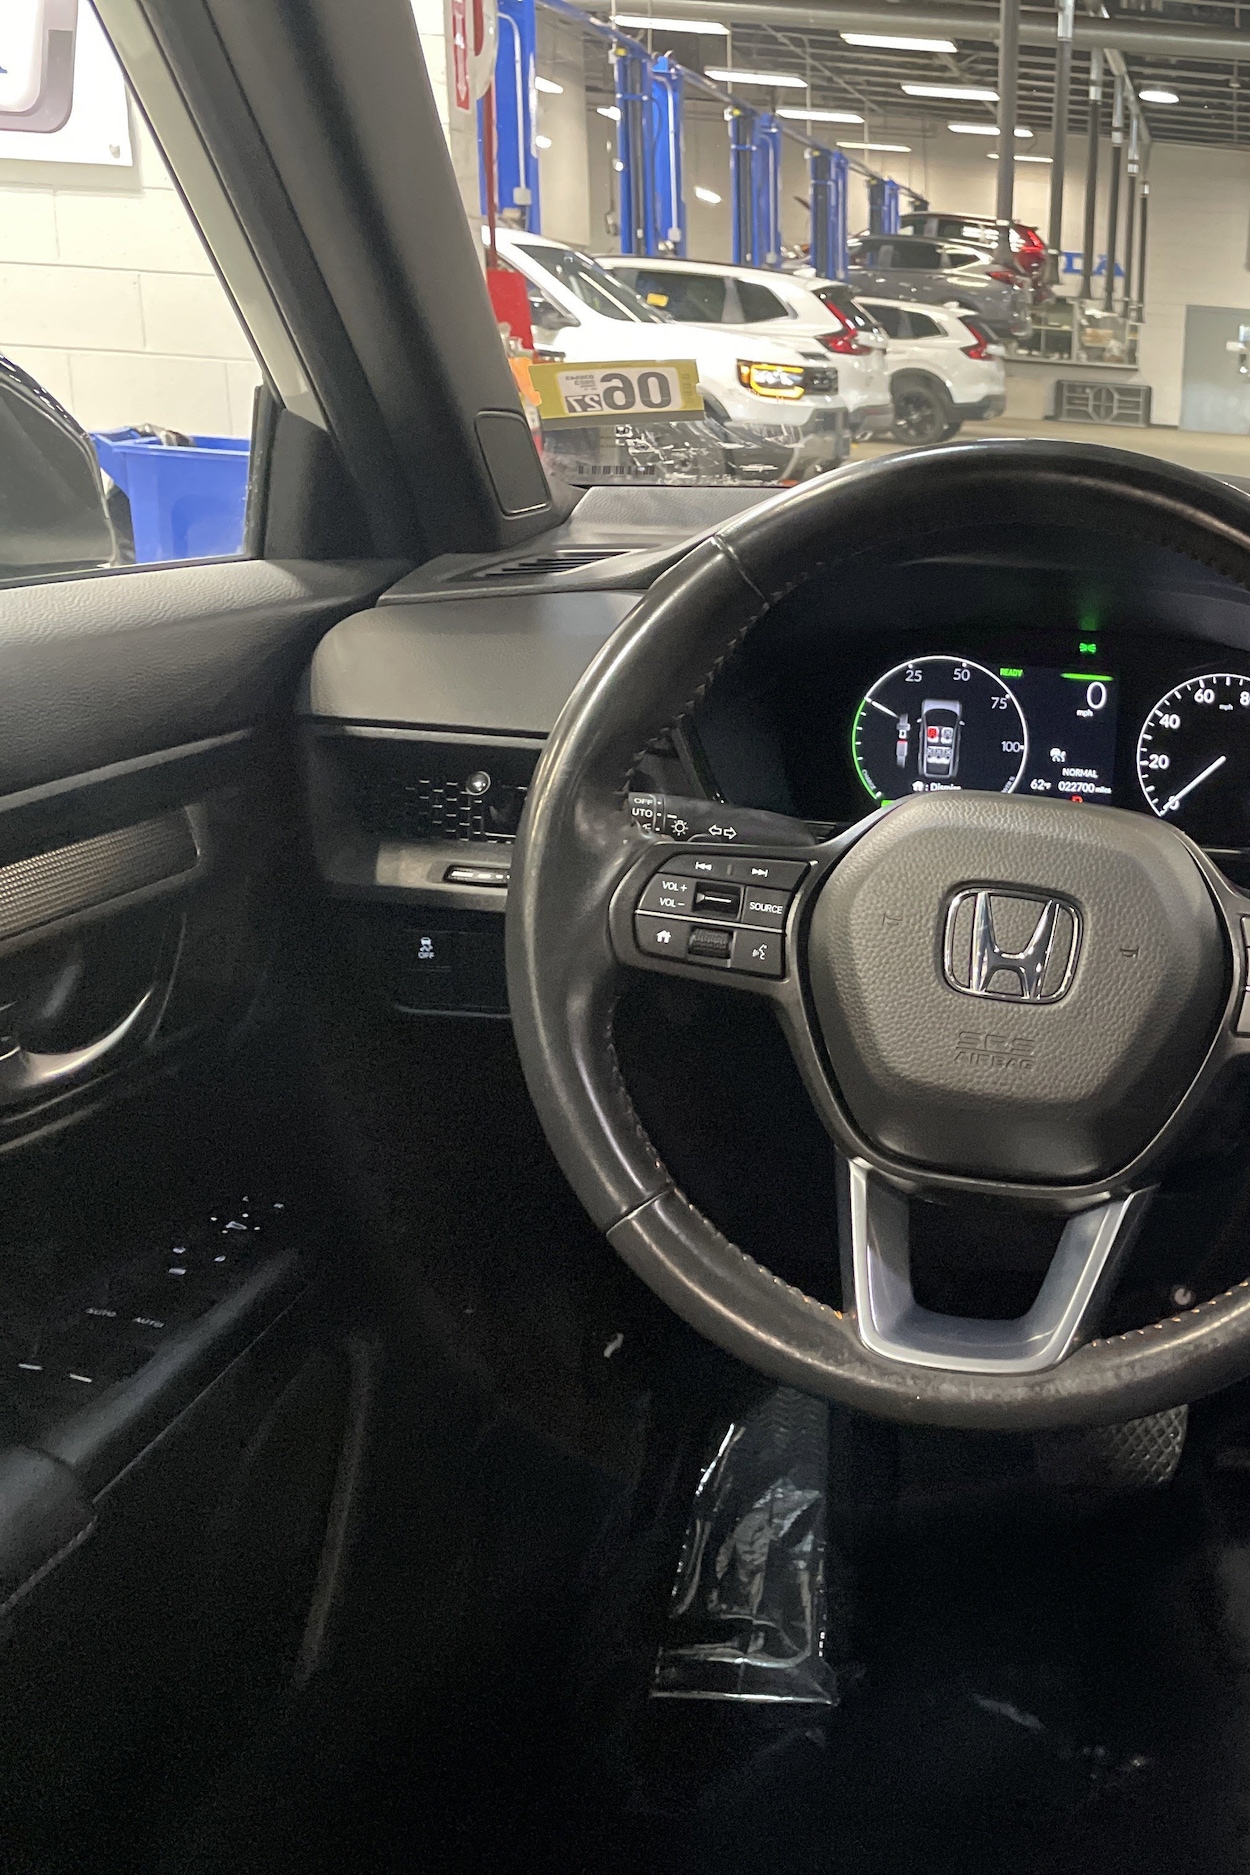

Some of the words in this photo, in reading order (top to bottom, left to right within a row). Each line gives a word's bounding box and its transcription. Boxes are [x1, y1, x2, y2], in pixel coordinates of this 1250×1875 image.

[905, 670, 922, 682] 25
[953, 669, 971, 681] 50
[1000, 668, 1024, 677] READY
[1087, 681, 1107, 709] 0
[1194, 689, 1215, 704] 60
[991, 697, 1008, 710] 75
[1076, 709, 1094, 718] mph
[1159, 714, 1181, 729] 40
[1001, 741, 1020, 753] 100
[1149, 754, 1170, 770] 20
[1062, 768, 1098, 778] NORMAL
[1058, 781, 1095, 793] 022700
[633, 797, 654, 806] OFF
[631, 807, 654, 818] UTO
[662, 881, 679, 892] VOL
[659, 897, 676, 907] VOL
[749, 901, 783, 914] SOURCE
